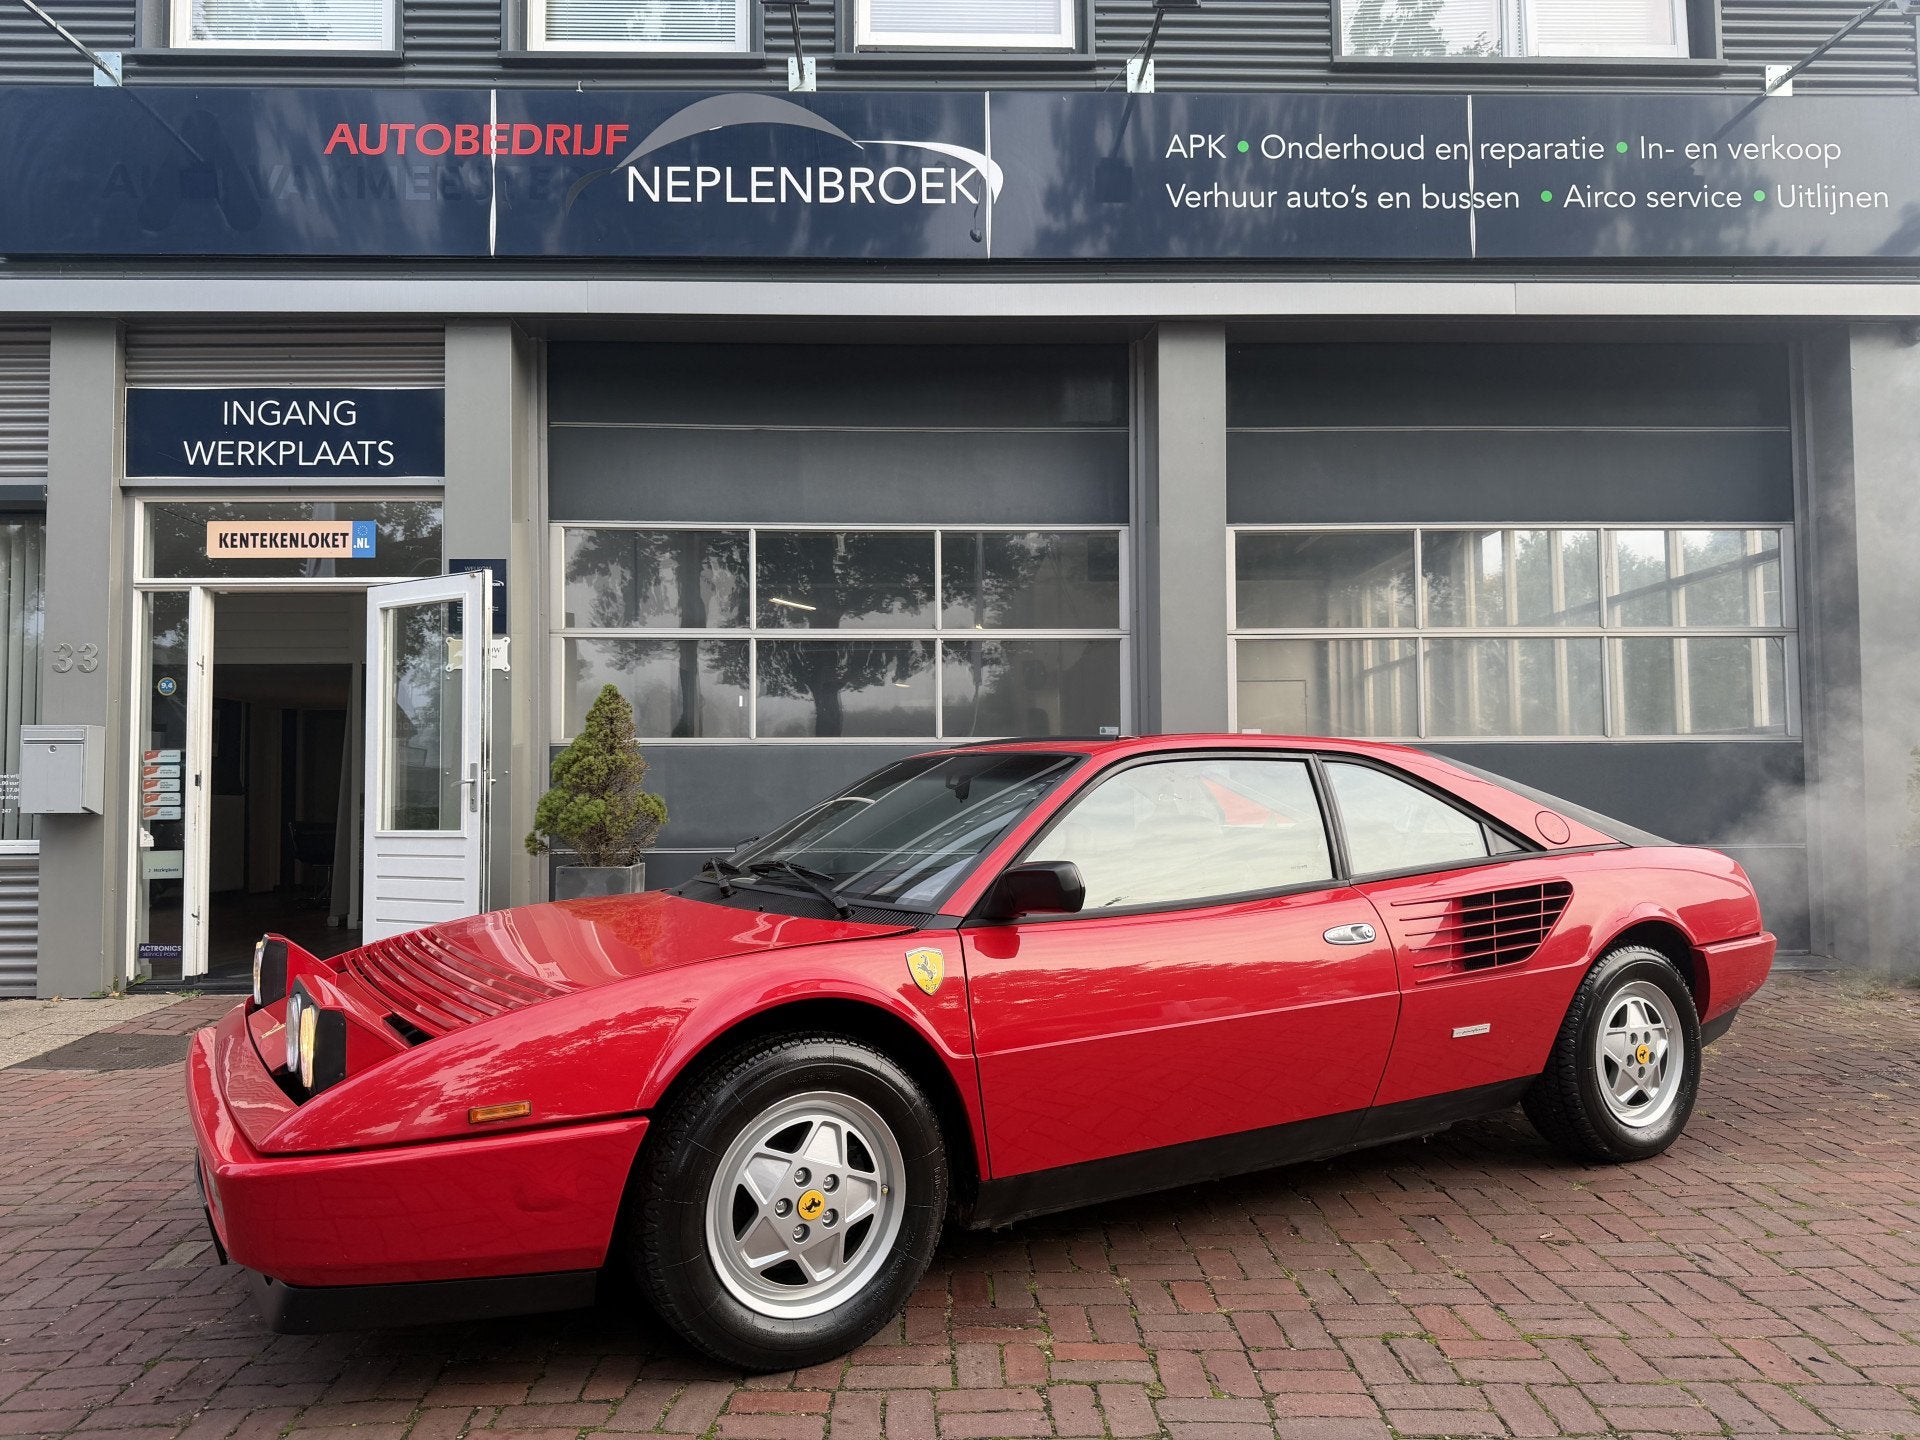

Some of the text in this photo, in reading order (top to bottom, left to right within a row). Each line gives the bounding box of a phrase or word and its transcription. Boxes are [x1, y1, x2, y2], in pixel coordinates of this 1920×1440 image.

[324, 123, 629, 156] AUTOBEDRIJF
[1165, 134, 1842, 168] APK Onderhoud en reparatie In- en verkoop
[628, 166, 980, 205] NEPLENBROEK
[1165, 182, 1889, 215] Verhuur auto's en bussen Airco service Uitlijnen
[223, 400, 357, 426] INGANG
[183, 440, 395, 466] WERKPLAATS
[219, 532, 349, 549] KENTEKENLOKET
[52, 643, 98, 674] 33
